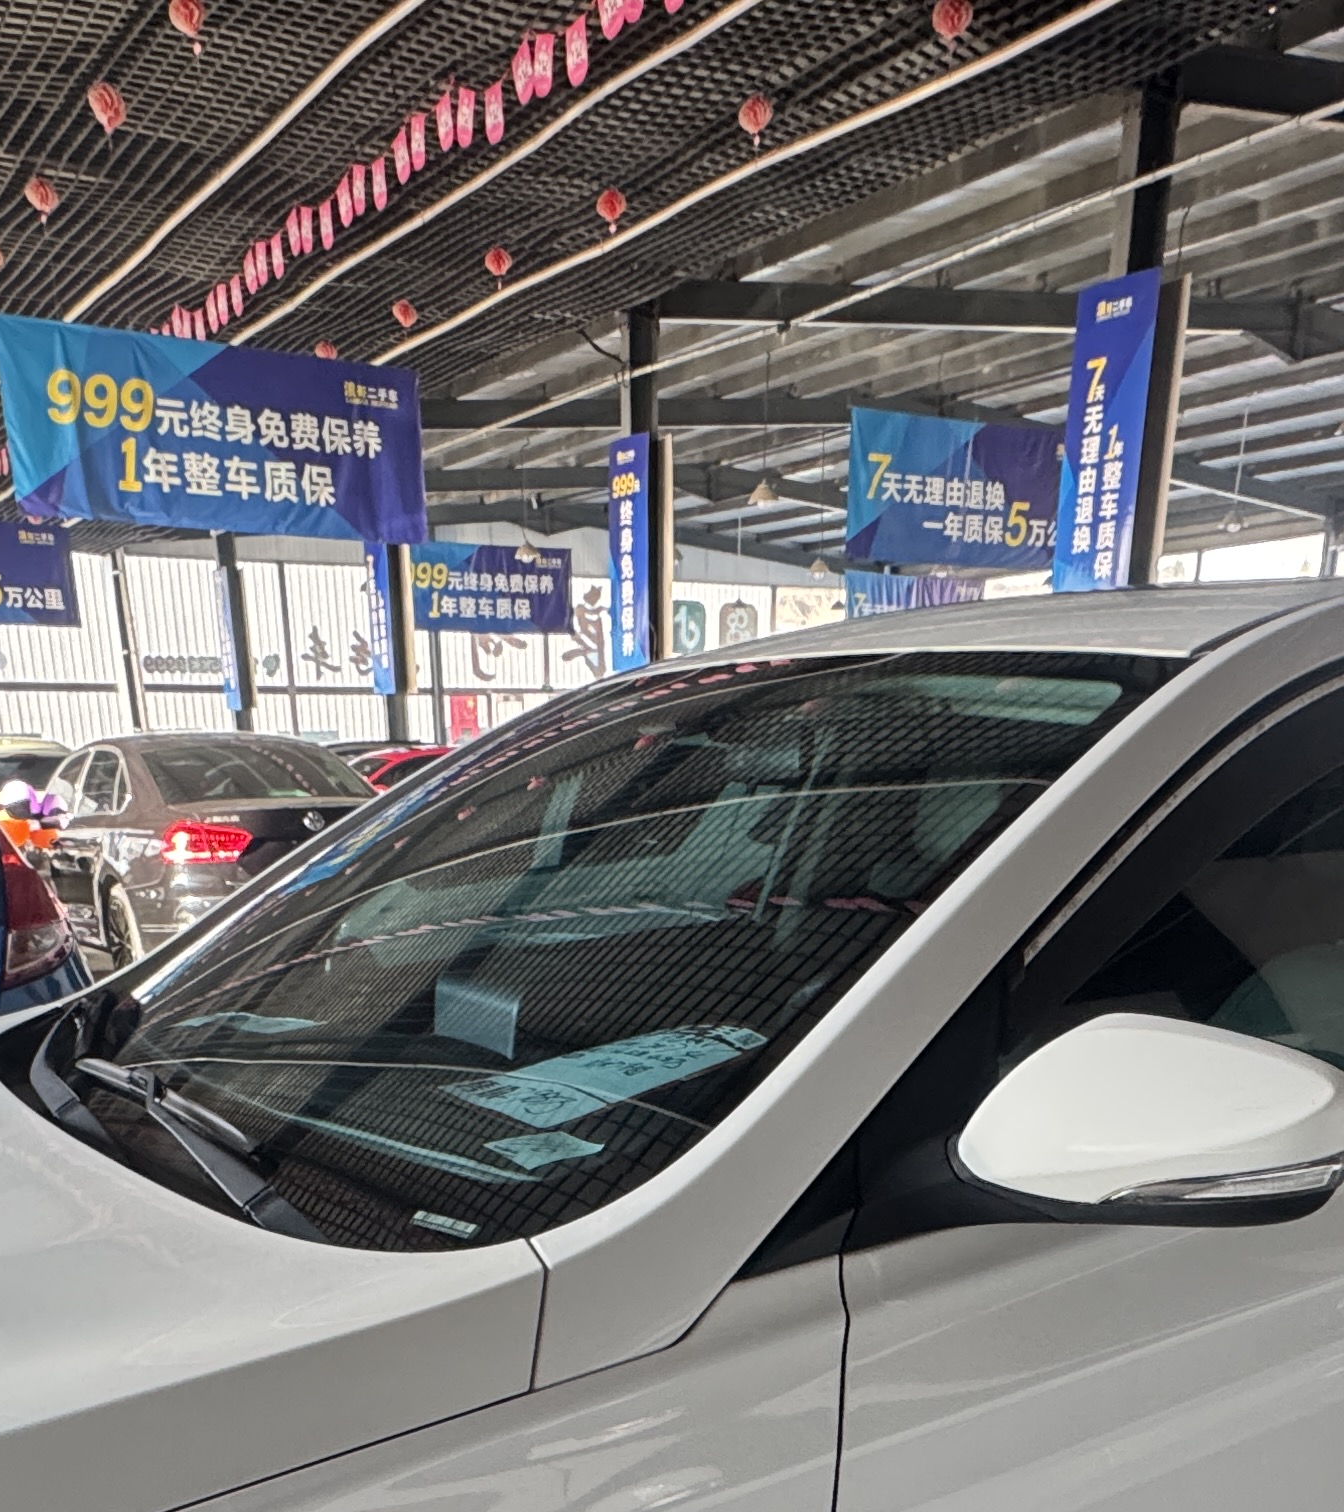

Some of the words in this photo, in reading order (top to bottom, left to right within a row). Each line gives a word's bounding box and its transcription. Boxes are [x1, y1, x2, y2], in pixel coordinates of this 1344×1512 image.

[47, 369, 383, 459] 999元终身免费保养
[119, 438, 336, 507] 1年整车质保
[866, 453, 1006, 511] 7天无理由退换
[1093, 424, 1124, 580] 1年整车质保
[411, 562, 554, 594] 99元终身免费保养
[428, 591, 532, 620] 1年整车质保
